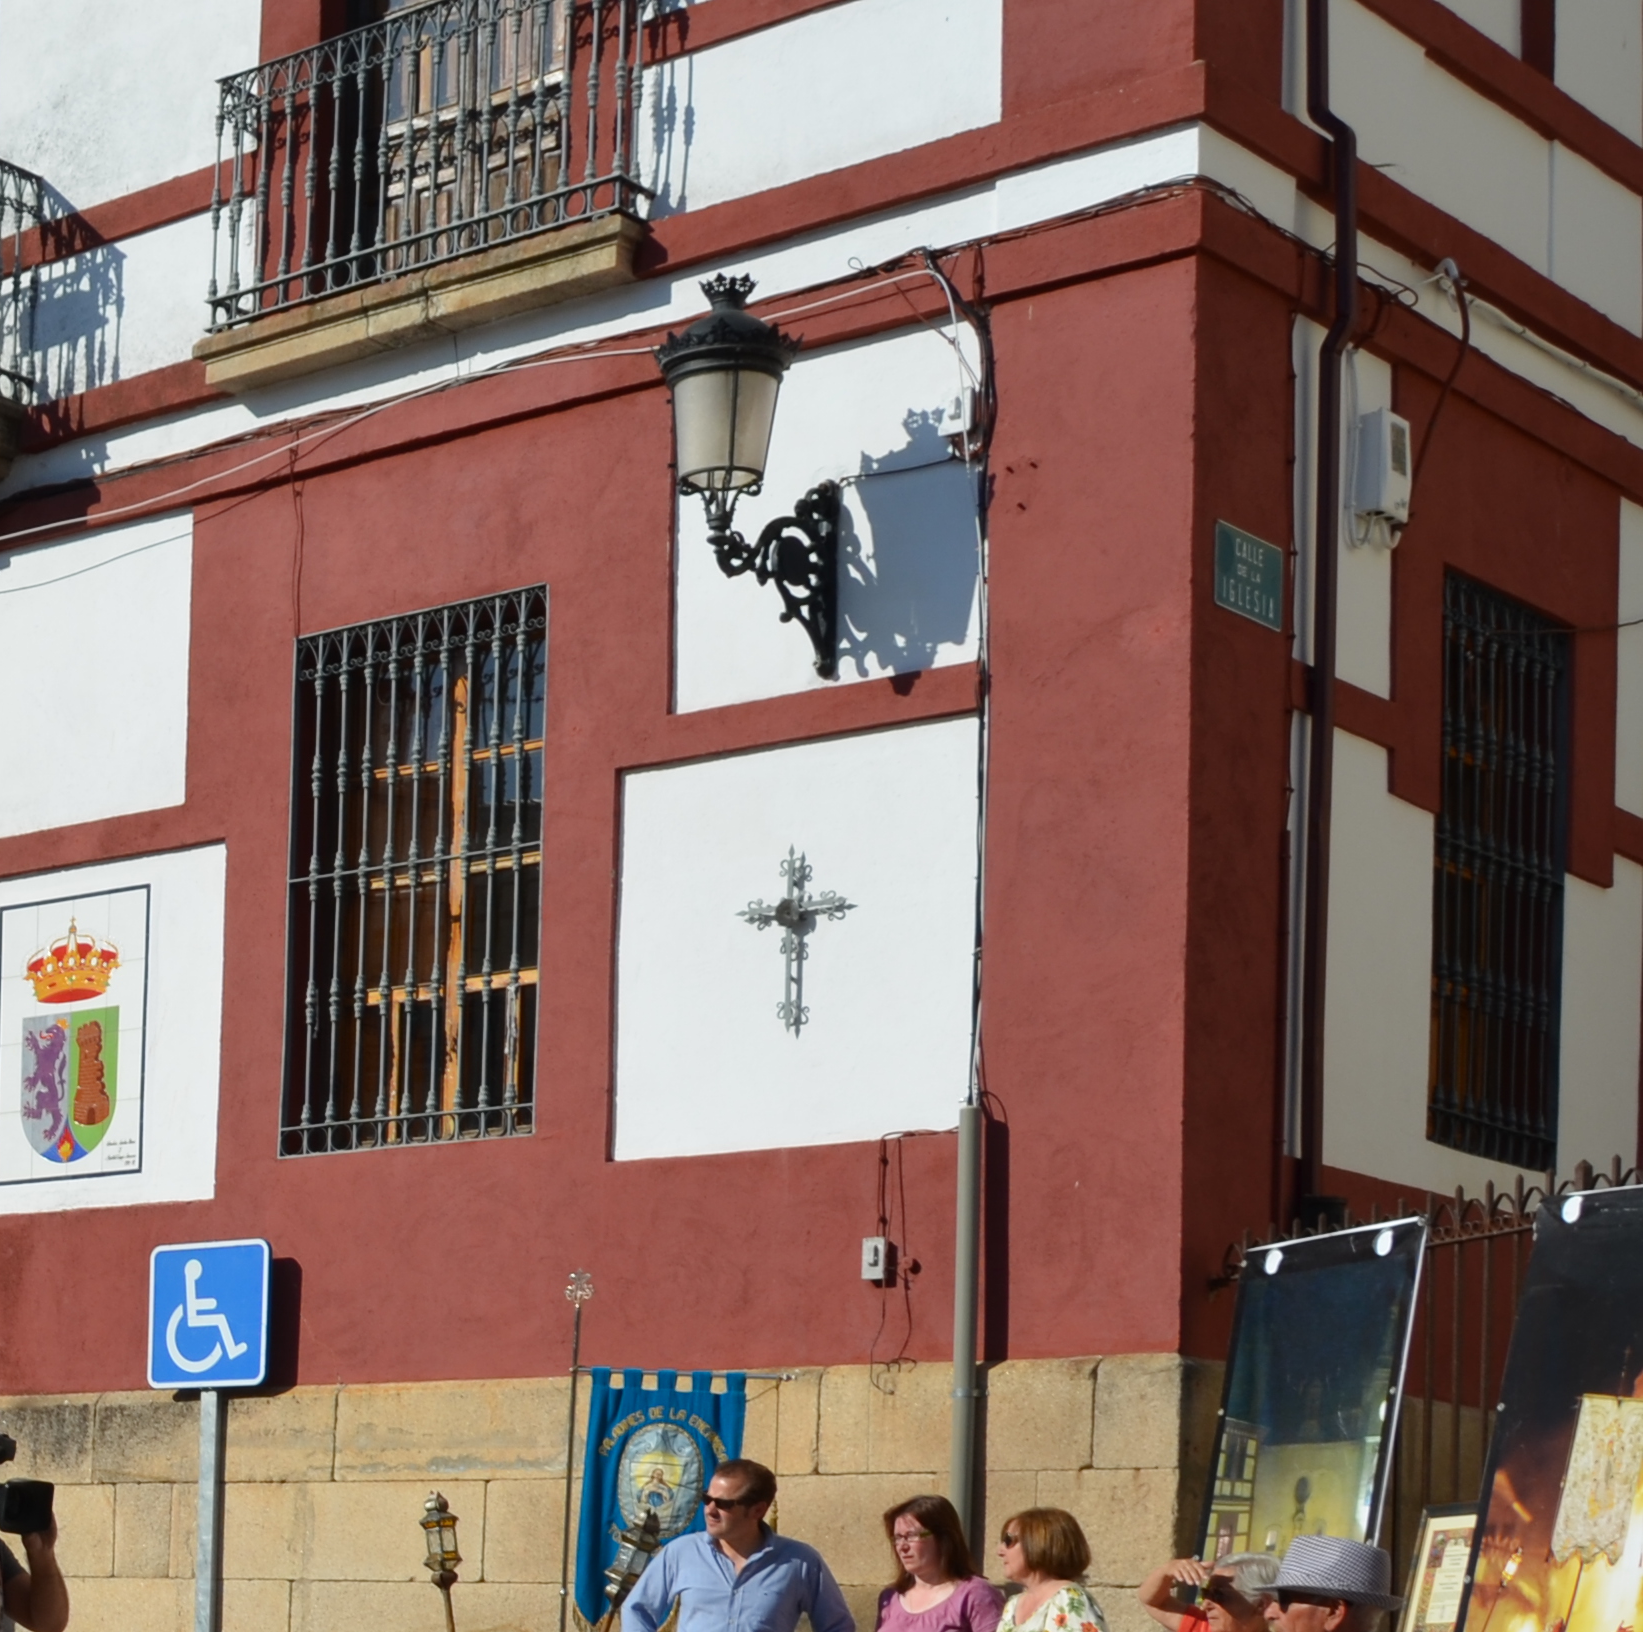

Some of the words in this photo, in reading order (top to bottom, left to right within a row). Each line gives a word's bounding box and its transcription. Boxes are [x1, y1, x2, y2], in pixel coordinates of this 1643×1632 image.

[1235, 538, 1264, 567] CALLE
[1236, 563, 1248, 578] DE
[1250, 571, 1261, 584] LA
[1222, 576, 1275, 620] IGLESIA
[649, 1405, 665, 1420] DE
[669, 1407, 687, 1421] LA
